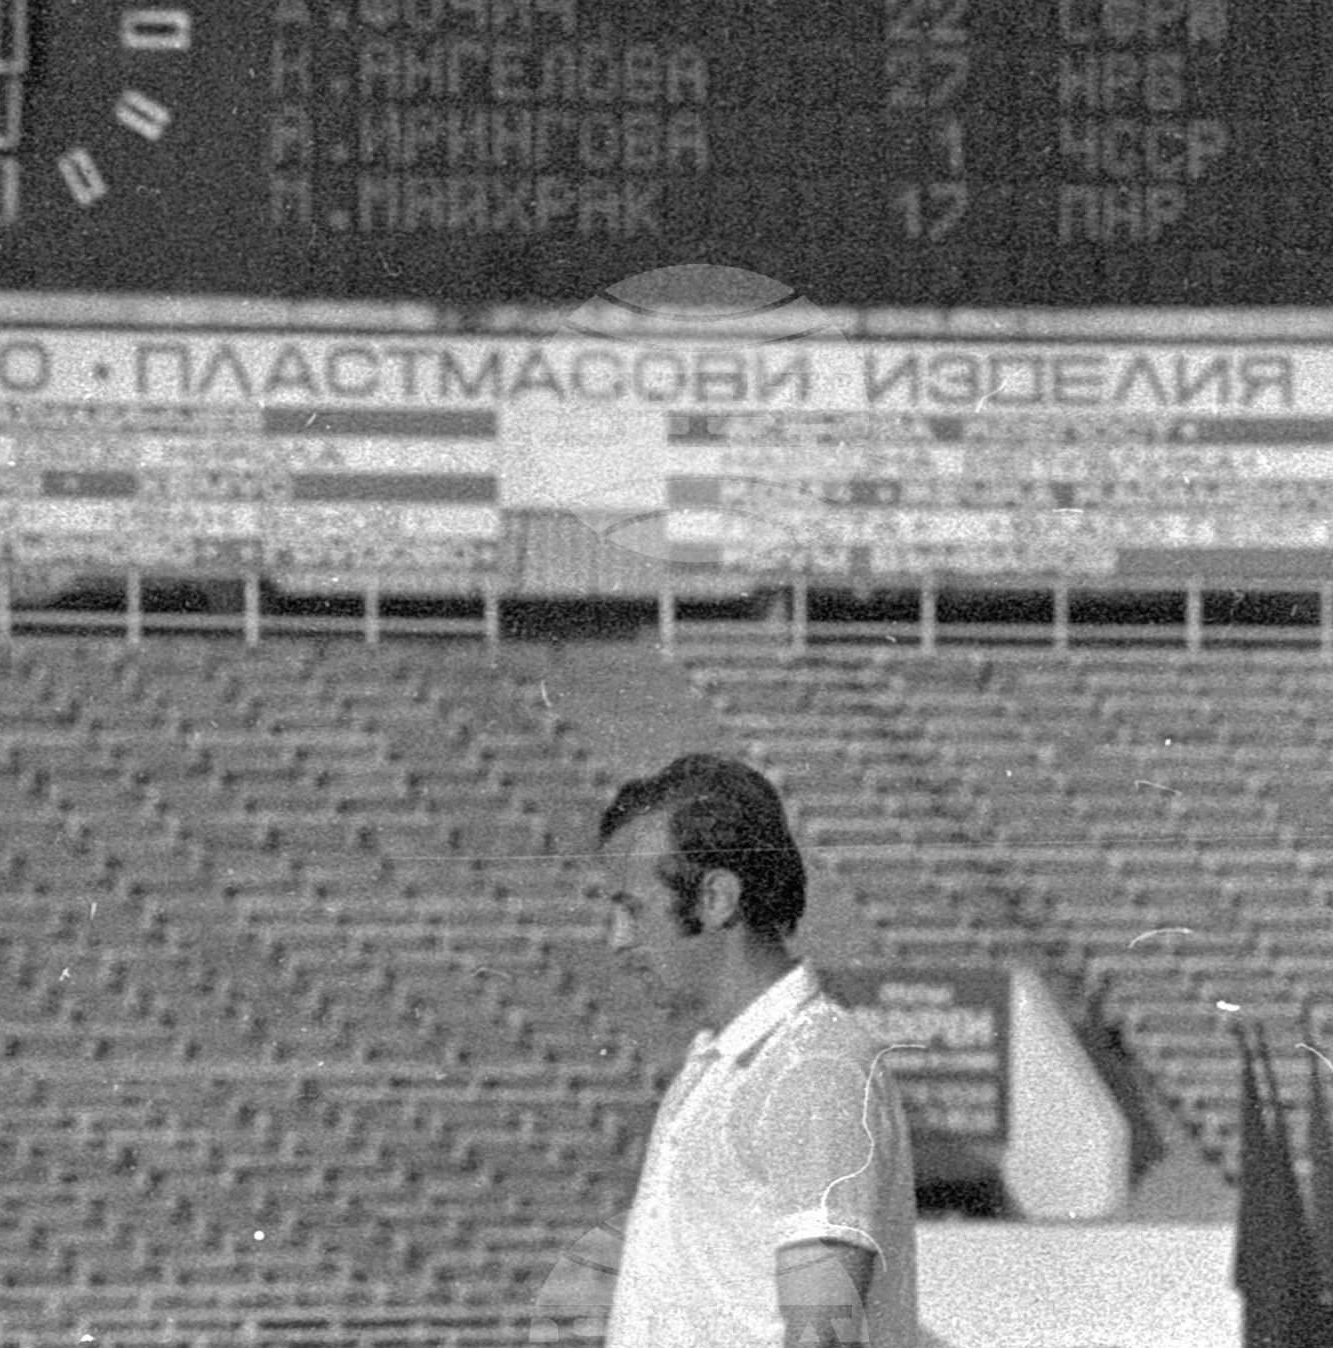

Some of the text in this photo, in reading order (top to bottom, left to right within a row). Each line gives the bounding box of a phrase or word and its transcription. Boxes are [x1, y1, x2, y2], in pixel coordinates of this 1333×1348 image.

[1059, 117, 1228, 179] ЧССР
[134, 342, 812, 402] ПЛАСТМАСОВИ
[863, 353, 1294, 406] ИЗДЕЛИЯ
